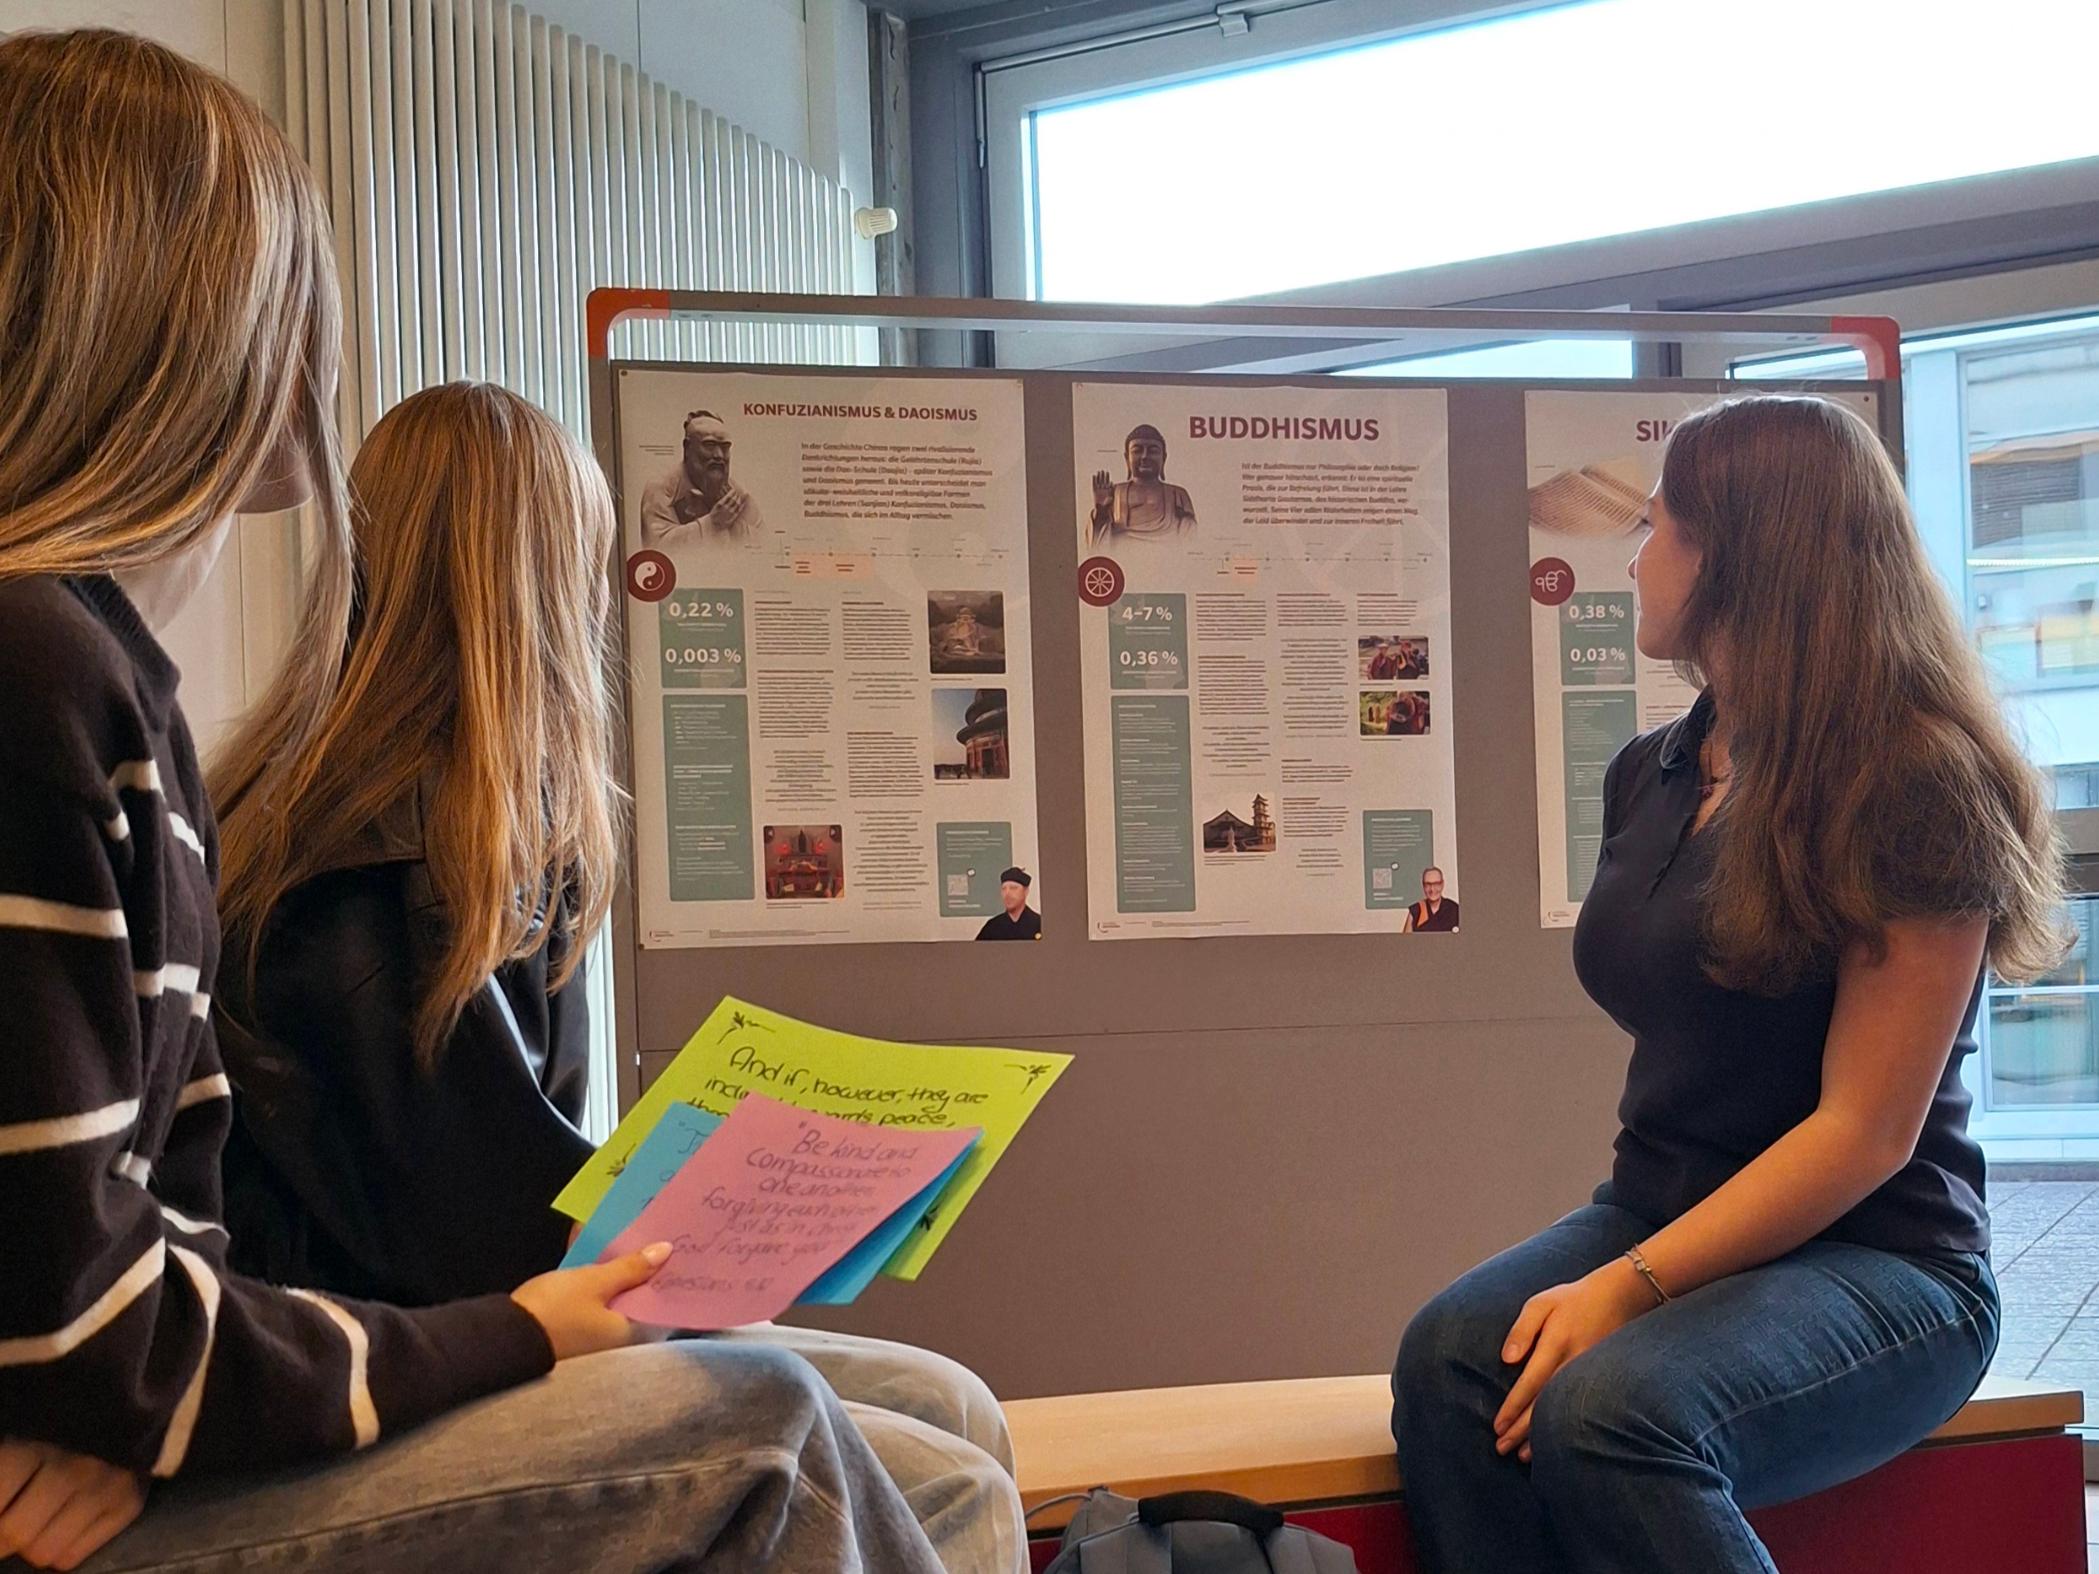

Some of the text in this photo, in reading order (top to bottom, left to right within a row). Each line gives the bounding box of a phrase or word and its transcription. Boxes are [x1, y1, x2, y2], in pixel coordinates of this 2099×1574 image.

[743, 402, 978, 421] KONFUZIANISMUS & DAOISMUS
[1189, 415, 1379, 441] BUDDHISMUS
[668, 602, 734, 618] 0,22 %
[1156, 606, 1173, 621] %
[1568, 604, 1625, 621] 0,38 %
[664, 648, 741, 664] 0,003 %
[1119, 650, 1178, 667] 0,36 %
[1570, 647, 1626, 664] 0,03 %
[729, 1045, 785, 1082] And
[813, 1077, 903, 1105] however,
[905, 1084, 951, 1114] they
[953, 1090, 989, 1105] are
